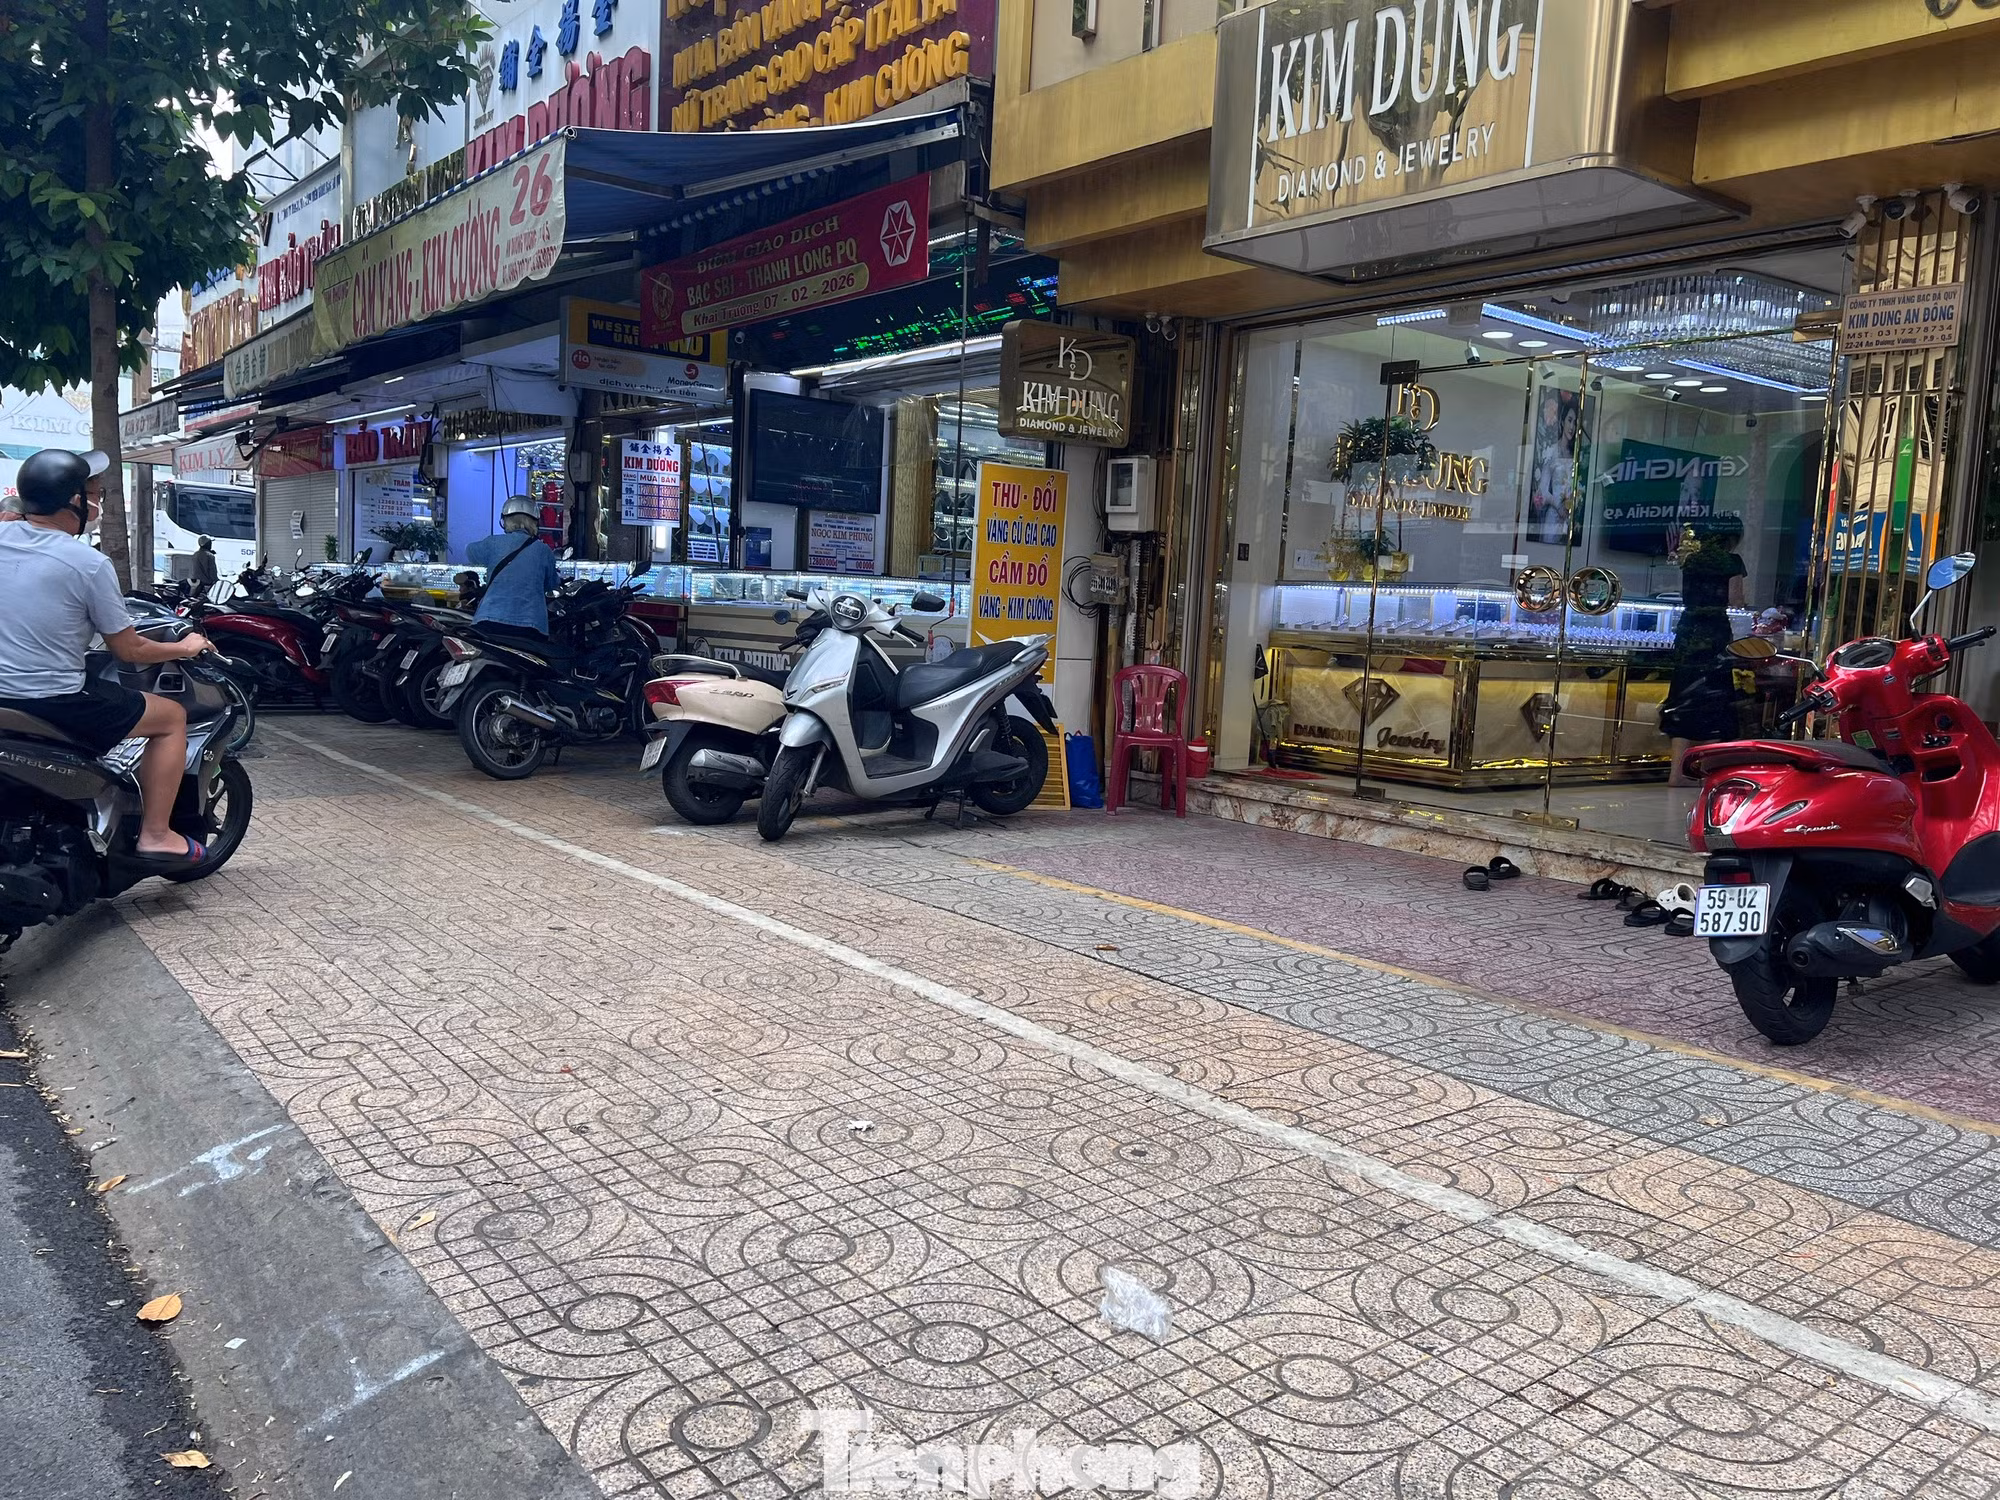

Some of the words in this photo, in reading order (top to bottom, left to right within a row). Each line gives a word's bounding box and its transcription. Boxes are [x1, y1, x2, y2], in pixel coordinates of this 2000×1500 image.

[672, 37, 717, 88] MUA
[717, 8, 761, 67] BÁN
[701, 65, 768, 128] TRANG
[767, 42, 813, 95] CAO
[813, 5, 864, 73] CẤP
[824, 74, 876, 126] KIM
[875, 31, 970, 108] CƯƠNG
[1267, 20, 1359, 143] KIM
[1368, 0, 1523, 116] DUNG
[1278, 162, 1365, 202] DIAMOND
[1374, 151, 1386, 179] &
[1394, 122, 1495, 174] JEWELRY
[510, 153, 553, 226] 26
[744, 234, 785, 259] GIAO
[790, 215, 840, 245] DỊCH
[420, 232, 447, 315] KIM
[450, 198, 500, 303] CƯƠNG
[746, 257, 791, 290] THANH
[794, 244, 833, 277] LONG
[836, 236, 858, 265] PQ
[693, 309, 718, 328] Khai
[764, 293, 779, 310] 07
[791, 286, 808, 304] 02
[821, 272, 855, 296] 2026
[1850, 298, 1866, 310] CÔNG
[1869, 299, 1877, 308] TY
[1879, 296, 1896, 307] TNHH
[1897, 293, 1915, 305] VÀNG
[592, 319, 640, 336] WESTE
[1848, 312, 1869, 330] KIM
[1872, 309, 1901, 328] DUNG
[1904, 308, 1920, 325] AN
[1922, 302, 1954, 322] ĐÔNG
[1845, 340, 1863, 350] 22-24
[1865, 339, 1873, 347] An
[1923, 334, 1935, 342] P.9
[1940, 333, 1953, 342] Q.5
[1847, 331, 1873, 340] MST:
[1877, 324, 1953, 338] 0317278734
[573, 351, 590, 363] ria
[599, 377, 621, 387] dịch
[624, 382, 637, 391] vụ
[668, 376, 715, 389] MoneyGram
[1022, 381, 1062, 416] KIM
[1066, 387, 1120, 423] DUNG
[1020, 417, 1066, 433] DIAMOND
[1068, 423, 1075, 433] &
[1077, 423, 1121, 438] JEWELRY
[180, 452, 204, 470] KIM
[624, 455, 644, 470] KIM
[647, 456, 679, 473] DƯƠNG
[1404, 451, 1489, 496] UNG
[639, 474, 658, 482] MUA
[991, 481, 1021, 508] THU
[1032, 475, 1057, 512] ĐỔI
[832, 530, 847, 540] KIM
[986, 513, 1009, 543] VÀNG
[1011, 515, 1023, 545] CŨ
[1025, 516, 1038, 546] GIÁ
[1040, 523, 1057, 547] CAO
[988, 551, 1023, 585] CẦM
[1026, 553, 1048, 587] ĐỒ
[979, 588, 1000, 618] VÀNG
[1007, 596, 1024, 620] KIM
[1026, 594, 1053, 621] CƯƠNG
[1294, 723, 1360, 743] DIAMOND
[1377, 726, 1446, 754] Jewelry
[1707, 887, 1758, 910] 59-U2
[1700, 910, 1761, 933] 587.90
